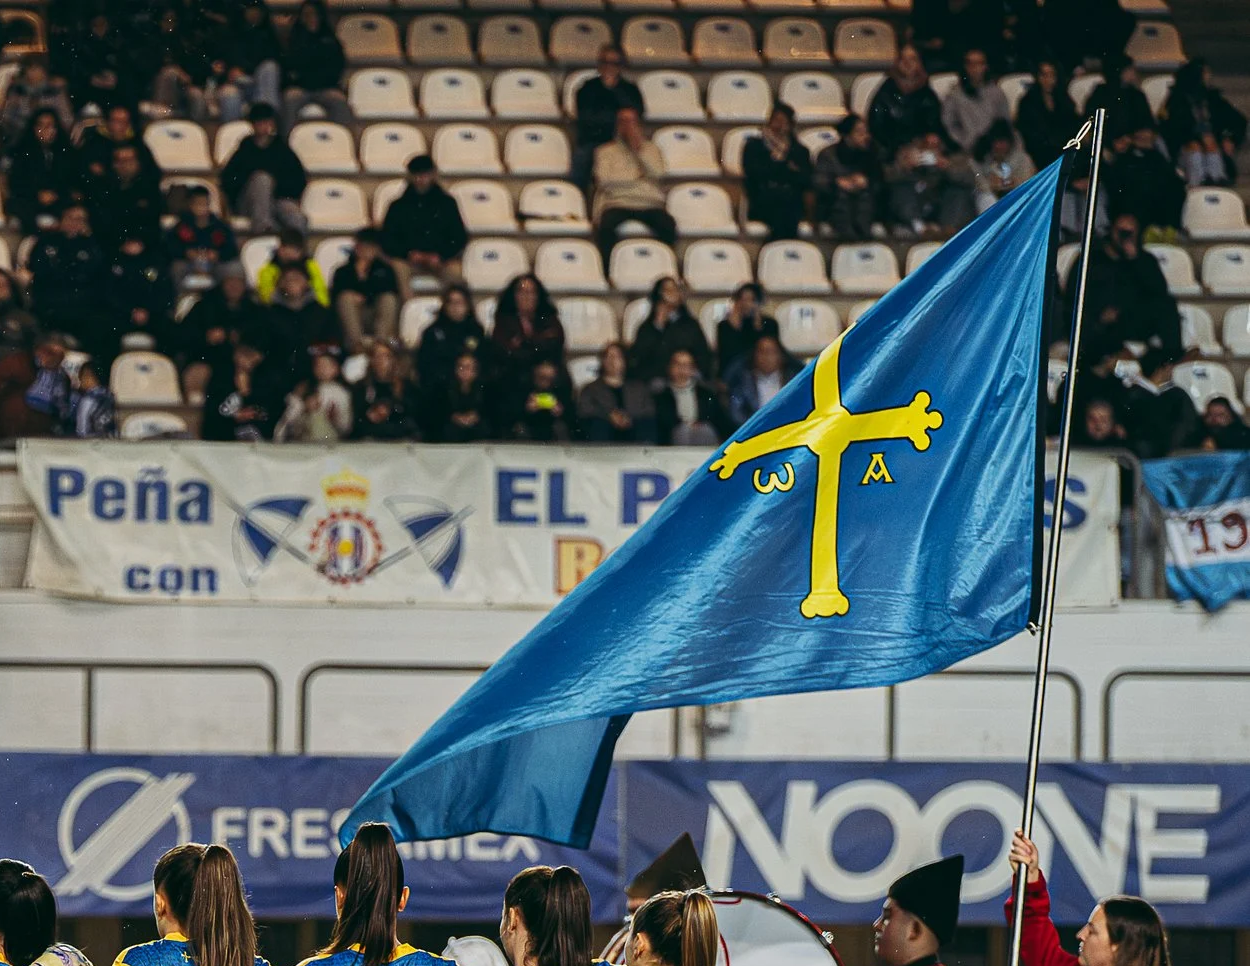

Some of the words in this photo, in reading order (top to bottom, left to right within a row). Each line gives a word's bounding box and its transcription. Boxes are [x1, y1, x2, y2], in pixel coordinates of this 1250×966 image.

[44, 464, 215, 526] Peña
[496, 469, 587, 526] EL
[124, 563, 218, 595] con
[702, 777, 1221, 906] NOONE
